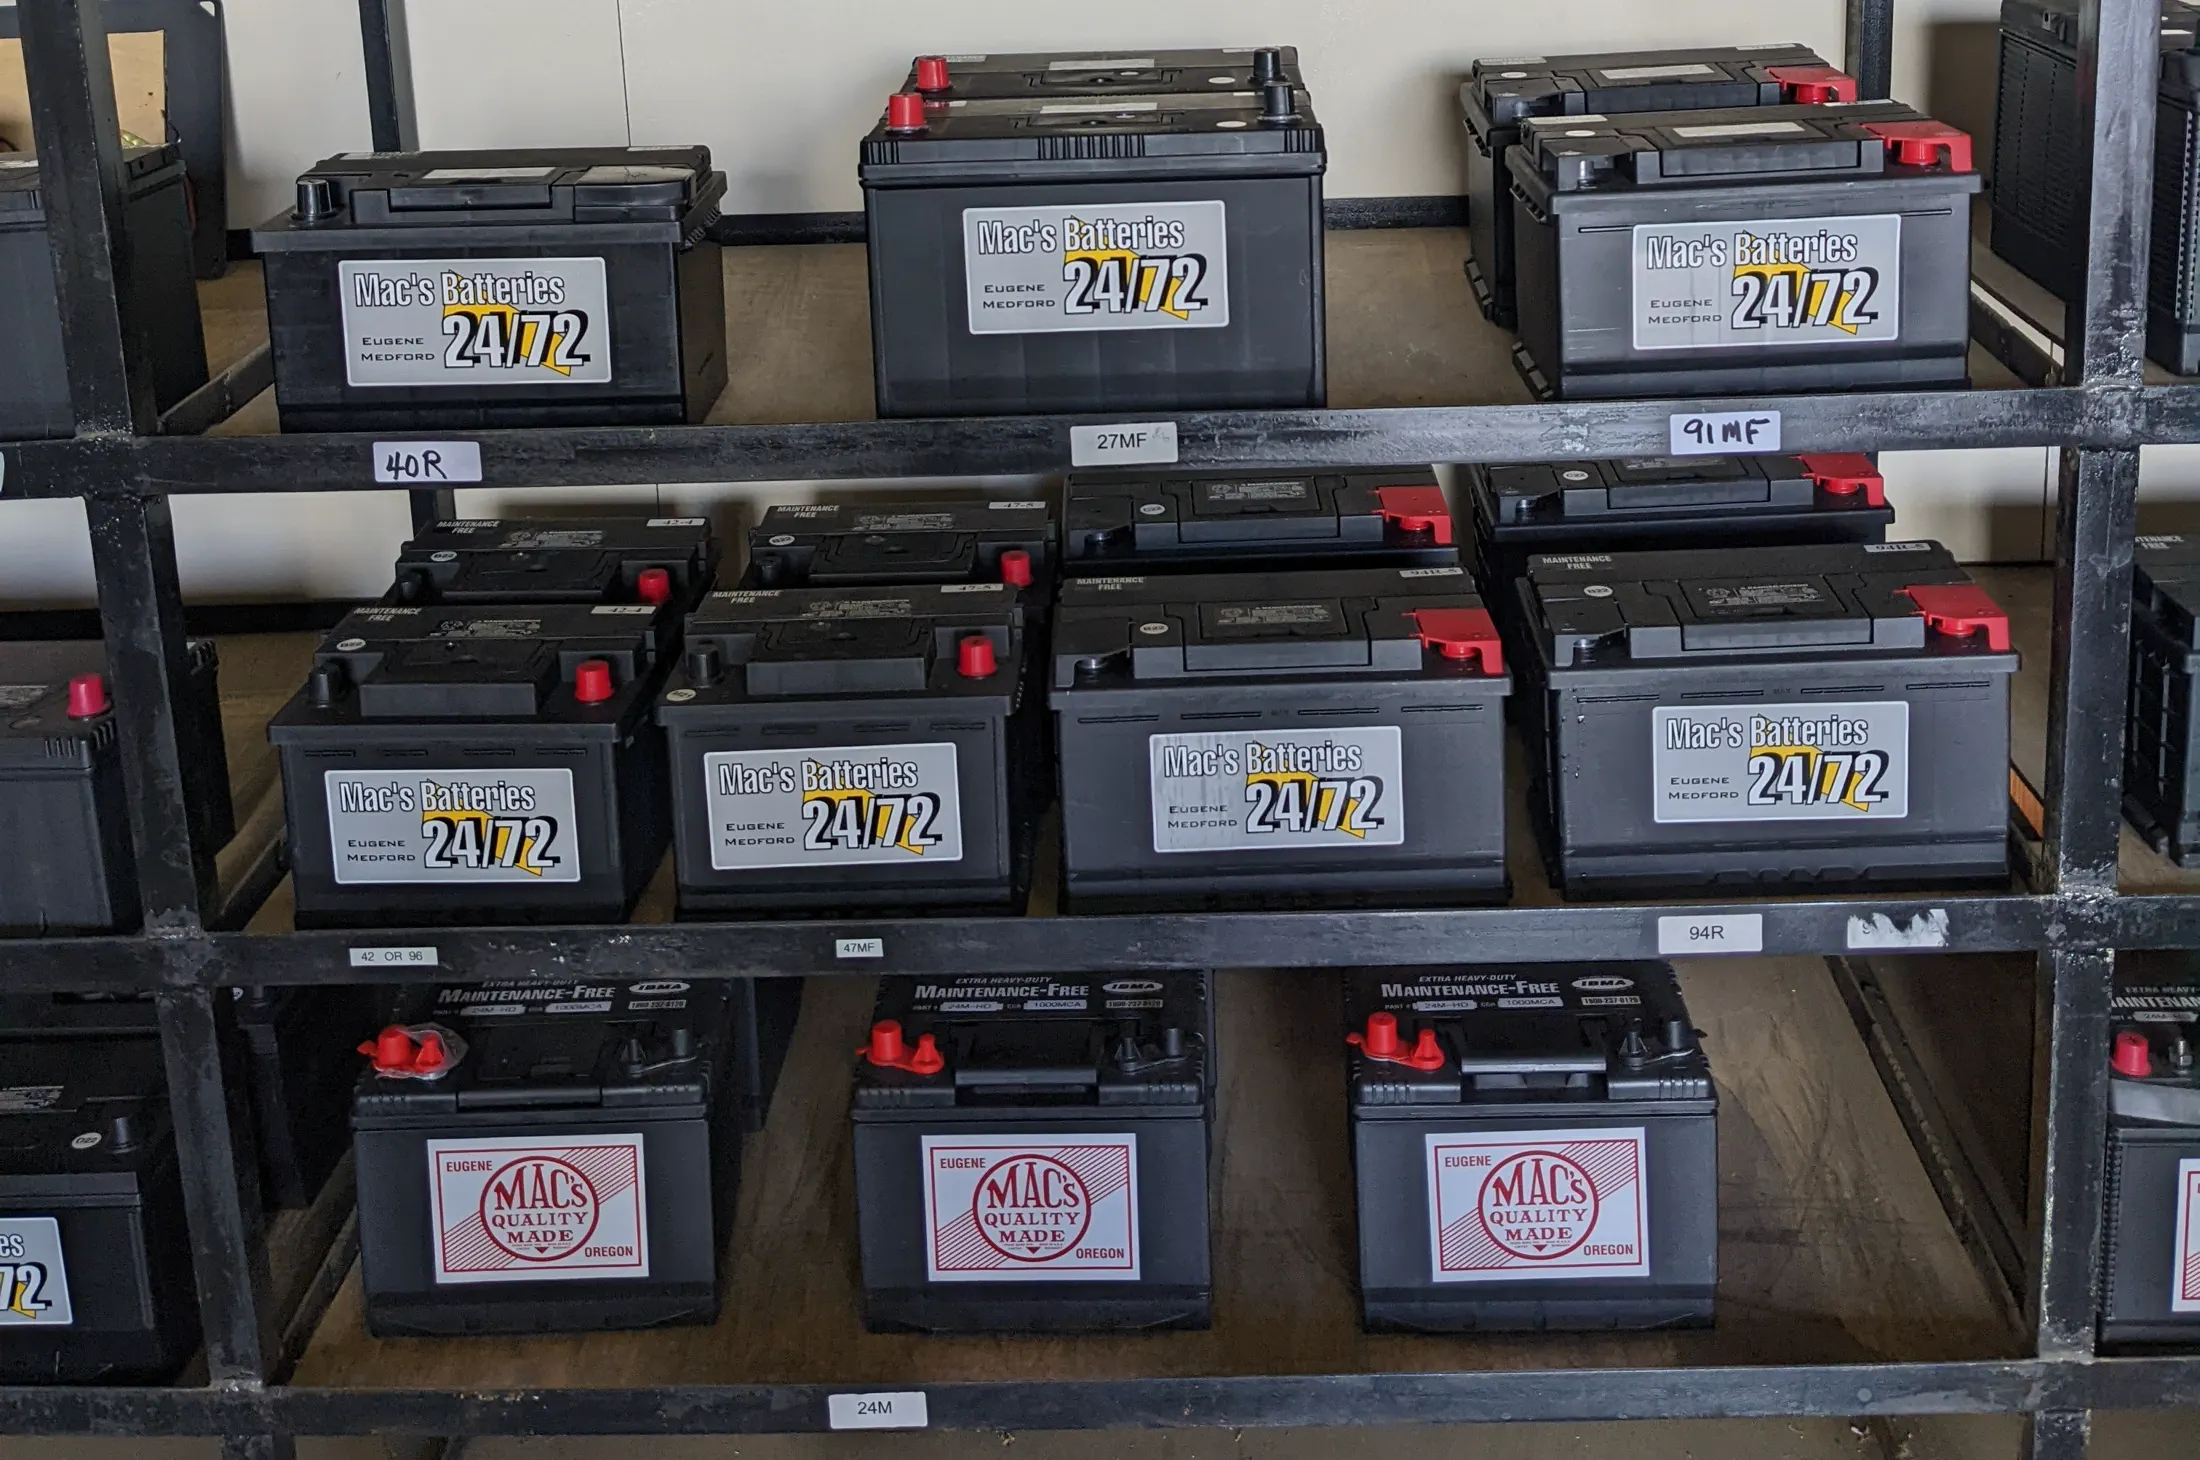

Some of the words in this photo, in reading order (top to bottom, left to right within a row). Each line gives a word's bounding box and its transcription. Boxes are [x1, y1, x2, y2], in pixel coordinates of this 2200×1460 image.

[978, 219, 1057, 254] Mac's
[1063, 215, 1184, 251] Batteries
[1647, 234, 1727, 269] Mac's
[1734, 229, 1858, 266] Batteries
[354, 272, 435, 307] Mac's
[440, 271, 565, 306] Batteries
[984, 284, 1045, 293] EUGENE
[1063, 253, 1208, 315] 24/72
[1731, 266, 1879, 329] 24/72
[983, 300, 1055, 309] MEDFORD
[1650, 299, 1713, 309] EUGENE
[1648, 314, 1722, 324] MEDFORD
[362, 337, 424, 345] EUGENE
[442, 310, 591, 368] 24/72
[361, 353, 435, 361] MEDFORD
[1097, 432, 1147, 449] 27MF
[386, 450, 447, 480] 40R
[1542, 556, 1611, 564] MAINTENANCE
[1076, 577, 1145, 585] MAINTENANCE
[712, 590, 784, 598] MAINTENANCE
[1098, 584, 1122, 592] FREE
[730, 596, 756, 604] FREE
[367, 614, 395, 622] FREE
[1666, 717, 1743, 749] Mac's
[1750, 715, 1868, 747] Batteries
[1164, 744, 1239, 777] Mac's
[1245, 740, 1362, 774] Batteries
[718, 762, 795, 795] Mac's
[801, 757, 918, 792] Batteries
[1671, 777, 1730, 785] EUGENE
[1748, 750, 1889, 805] 24/72
[339, 781, 414, 812] Mac's
[420, 780, 535, 811] Batteries
[1669, 791, 1739, 800] MEDFORD
[1169, 804, 1228, 813] EUGENE
[1244, 775, 1385, 834] 24/72
[726, 822, 785, 831] EUGENE
[801, 792, 943, 850] 24/72
[1168, 819, 1237, 828] MEDFORD
[421, 815, 561, 869] 24/72
[725, 836, 795, 845] MEDFORD
[348, 854, 415, 862] MEDFORD
[1689, 925, 1724, 940] 94R
[844, 943, 875, 952] 47MF
[361, 952, 375, 961] 42
[384, 951, 403, 961] OR
[409, 951, 423, 961] 96
[437, 985, 615, 1003] MAINTENANCE-FREE
[915, 984, 1089, 999] MAINTENANCE-FREE
[1381, 981, 1559, 997] MAINTENANCE-FREE
[446, 1160, 492, 1172] EUGENE
[940, 1158, 986, 1169] EUGENE
[1445, 1156, 1491, 1167] EUGENE
[492, 1211, 588, 1229] QUALITY
[984, 1212, 1080, 1228] QUALITY
[1490, 1208, 1588, 1226] QUALITY
[507, 1230, 573, 1243] MADE
[1000, 1230, 1065, 1242] MADE
[1505, 1227, 1572, 1241] MADE
[585, 1246, 633, 1257] OREGON
[1076, 1248, 1124, 1259] OREGON
[1584, 1244, 1633, 1256] OREGON
[857, 1401, 892, 1415] 24M
